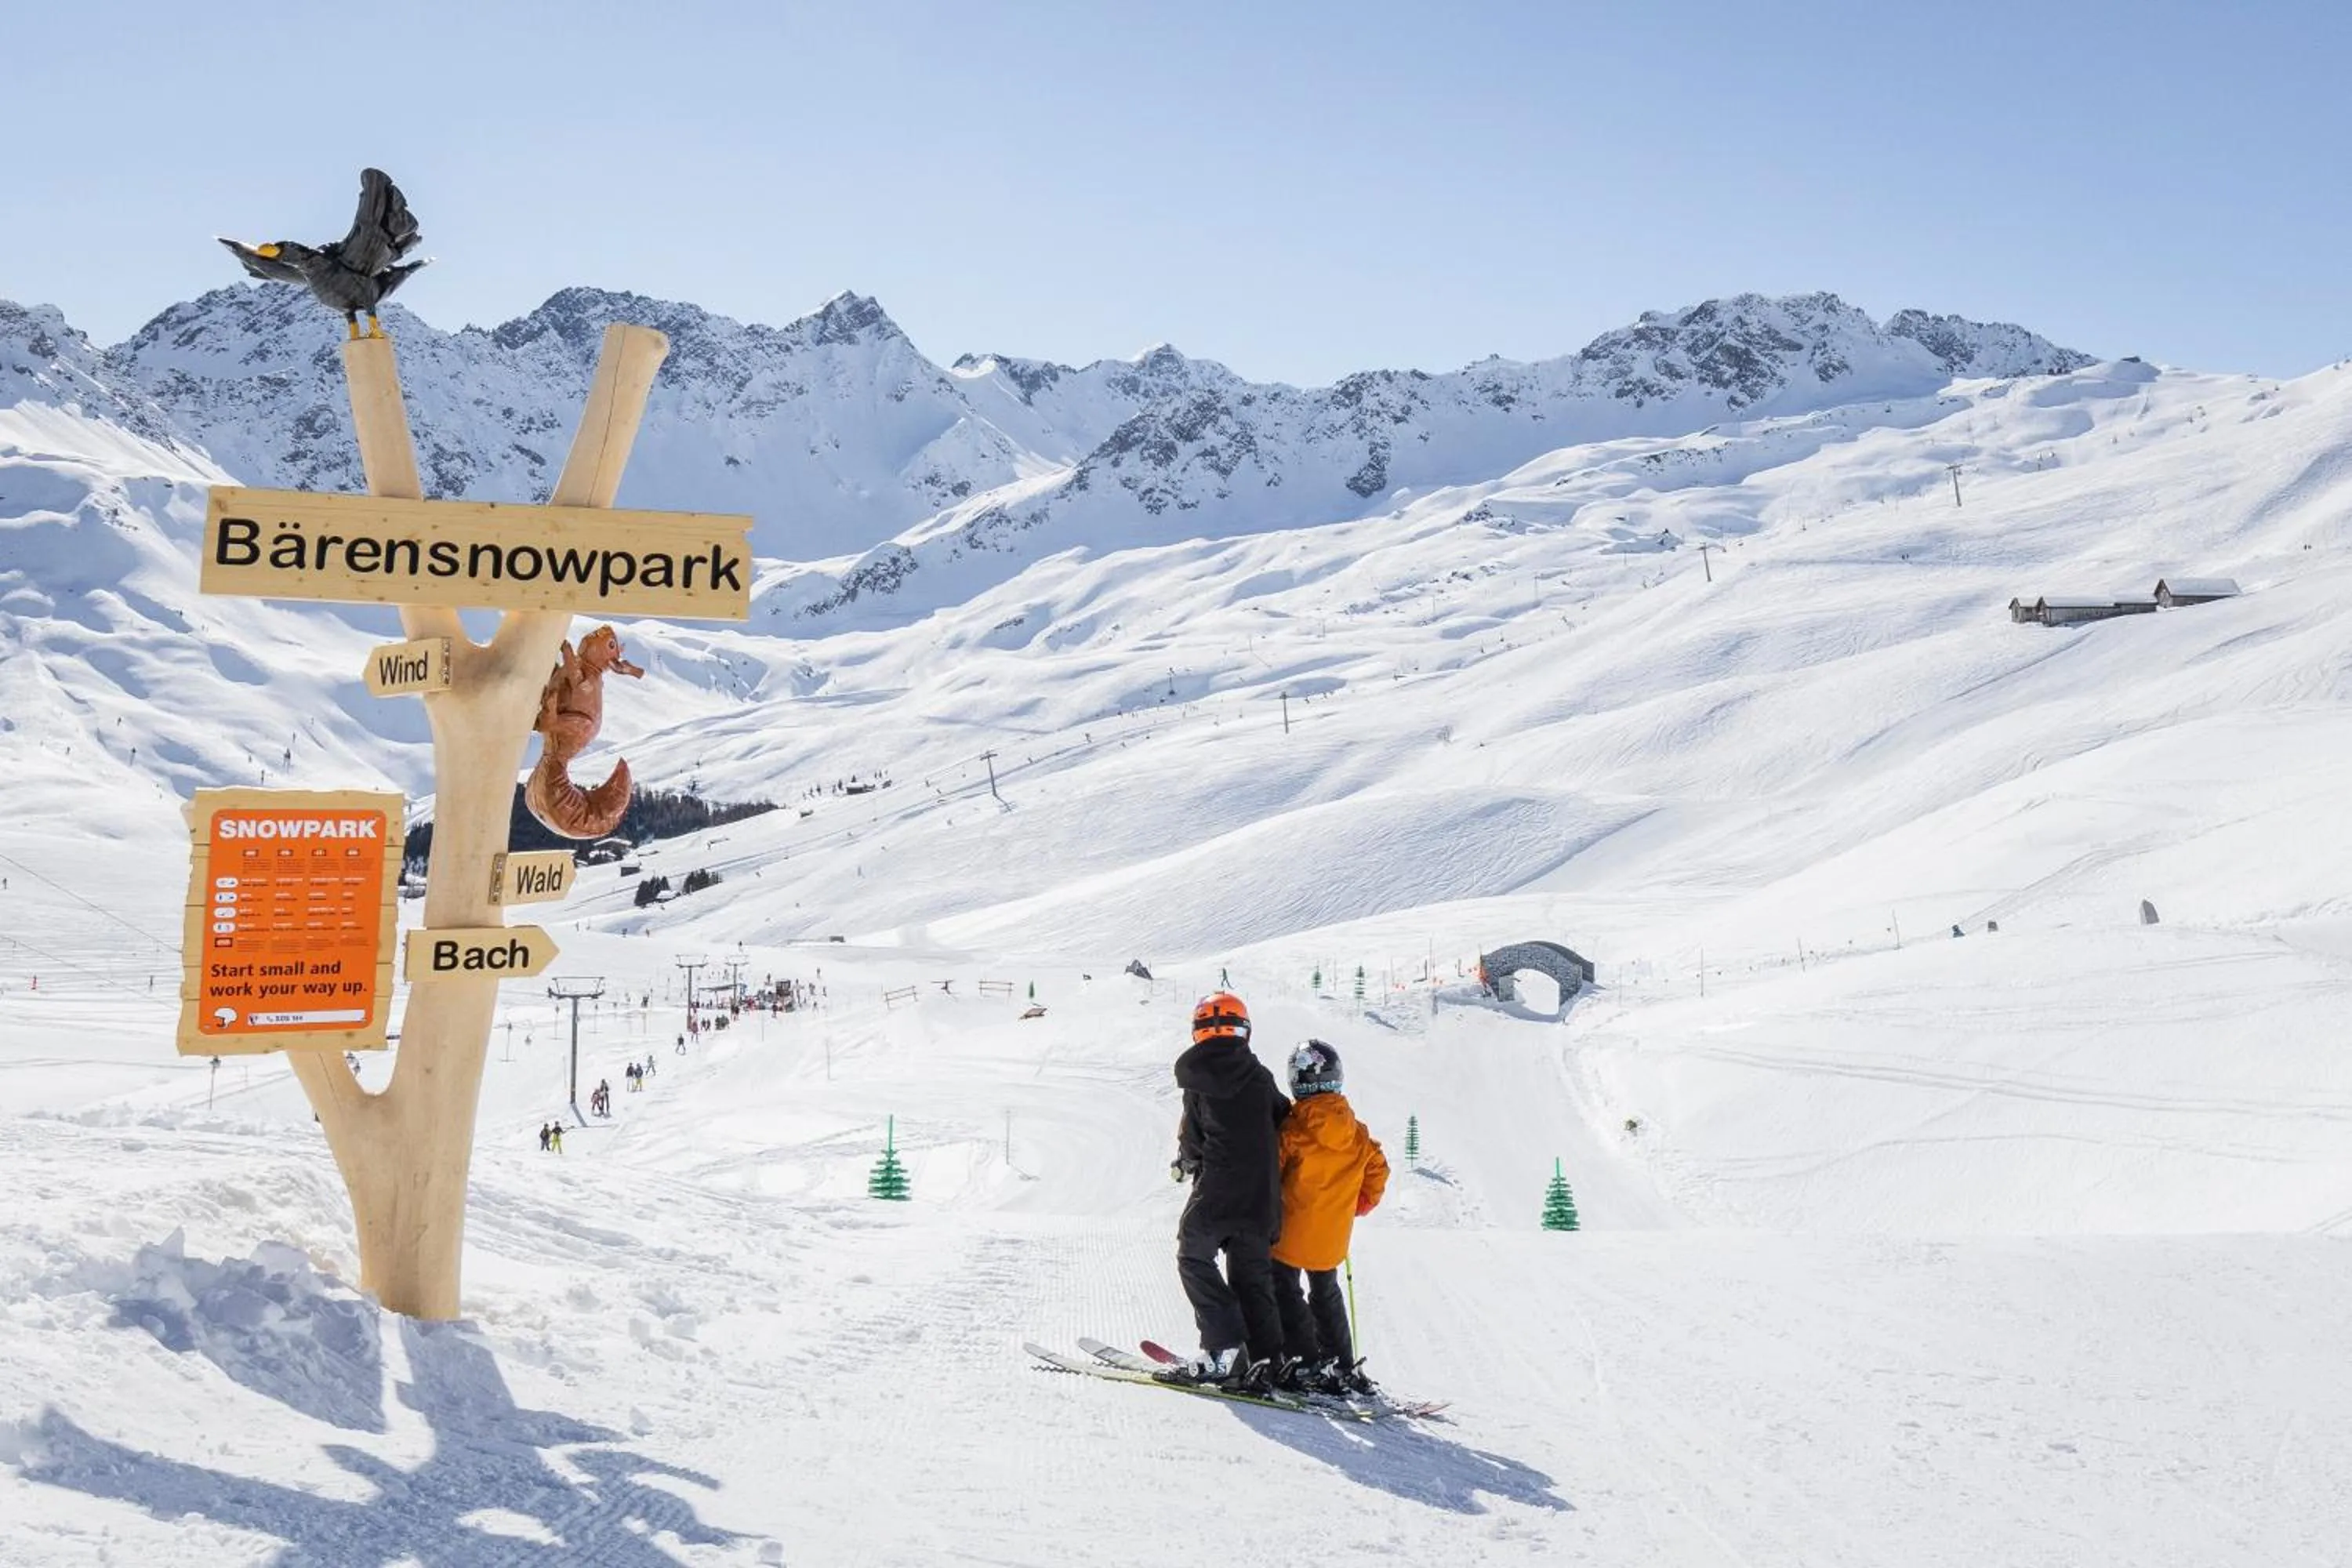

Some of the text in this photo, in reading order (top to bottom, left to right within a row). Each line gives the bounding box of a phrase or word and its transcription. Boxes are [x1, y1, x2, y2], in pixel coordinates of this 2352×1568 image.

[216, 517, 741, 597] Bärensnowpark
[379, 650, 428, 686] Wind
[219, 818, 377, 839] SNOWPARK
[517, 862, 564, 895] Wald
[210, 960, 342, 978] Start small and
[433, 938, 529, 971] Bach
[209, 981, 368, 999] work your way up.
